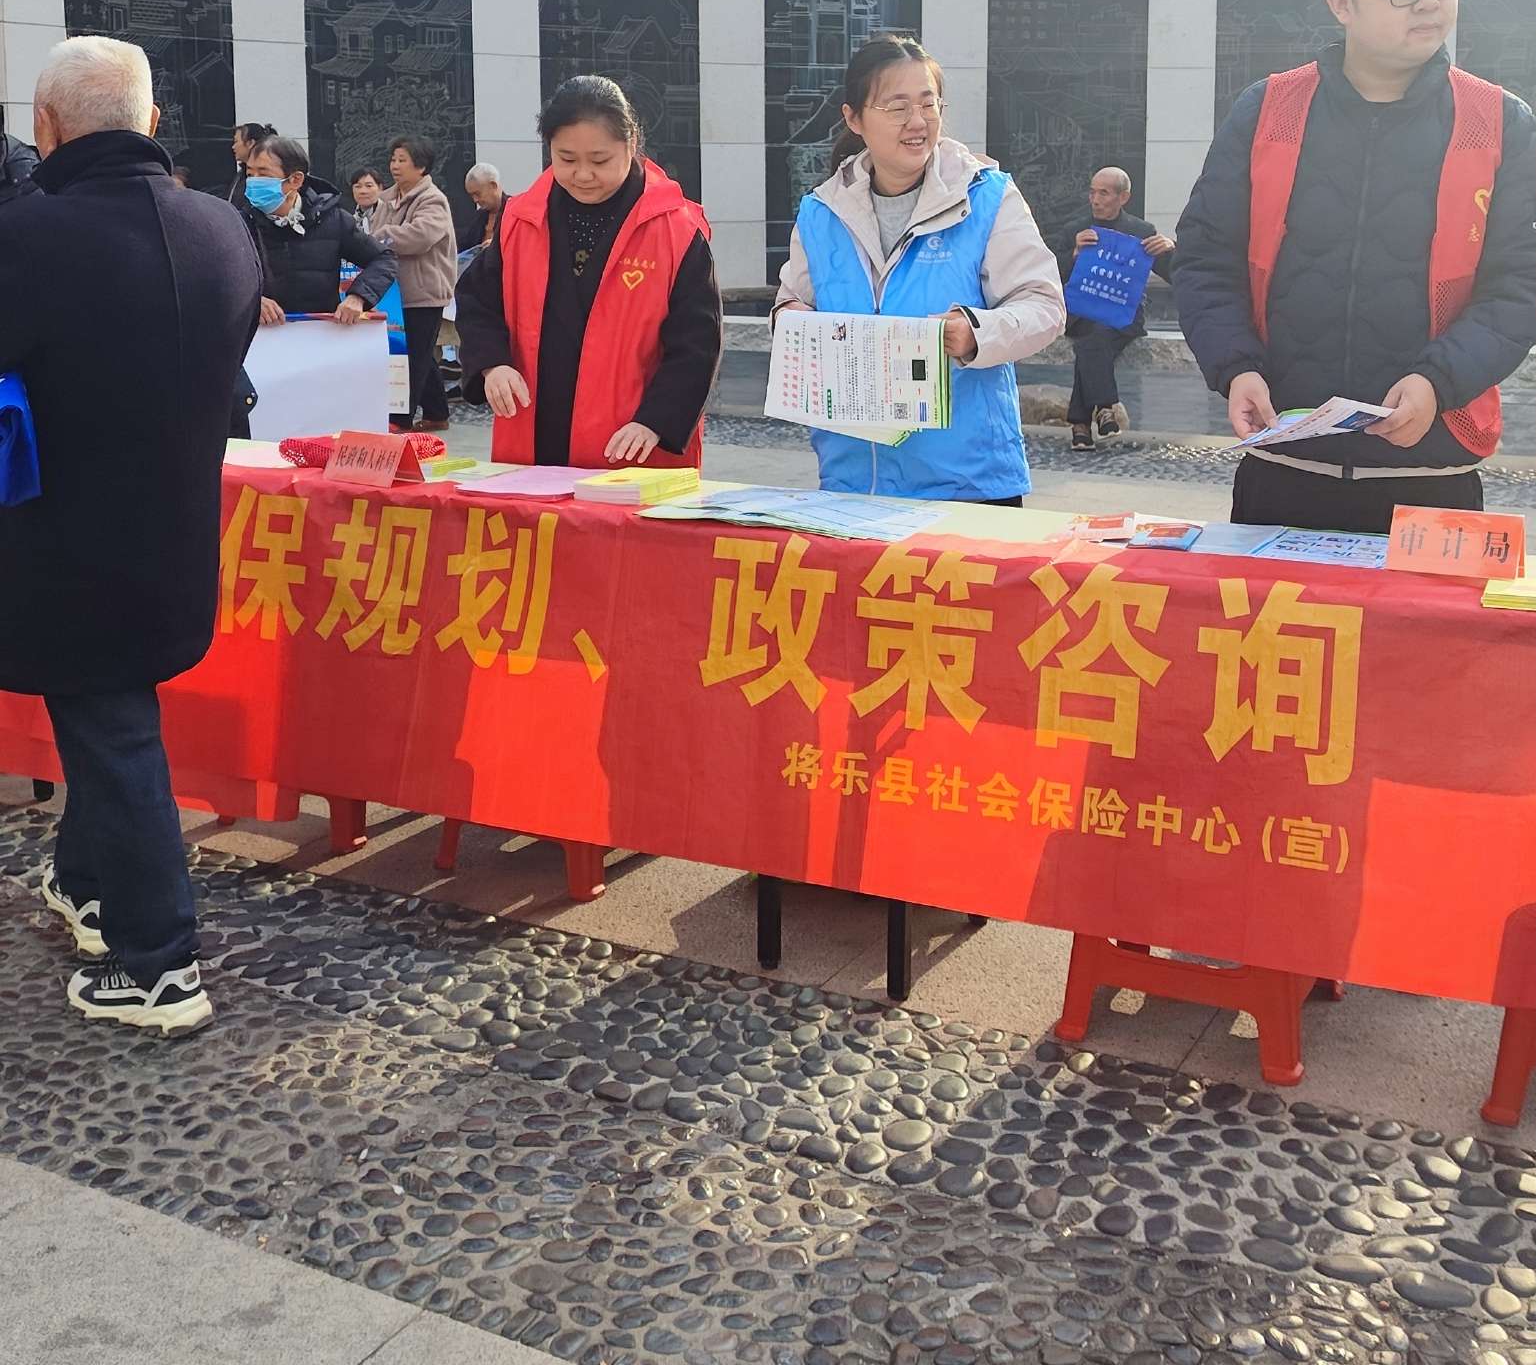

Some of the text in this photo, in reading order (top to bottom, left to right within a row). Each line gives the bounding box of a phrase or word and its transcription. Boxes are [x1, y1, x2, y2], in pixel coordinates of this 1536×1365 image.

[1399, 522, 1511, 565] 审计局
[699, 532, 1366, 787] 政策咨询
